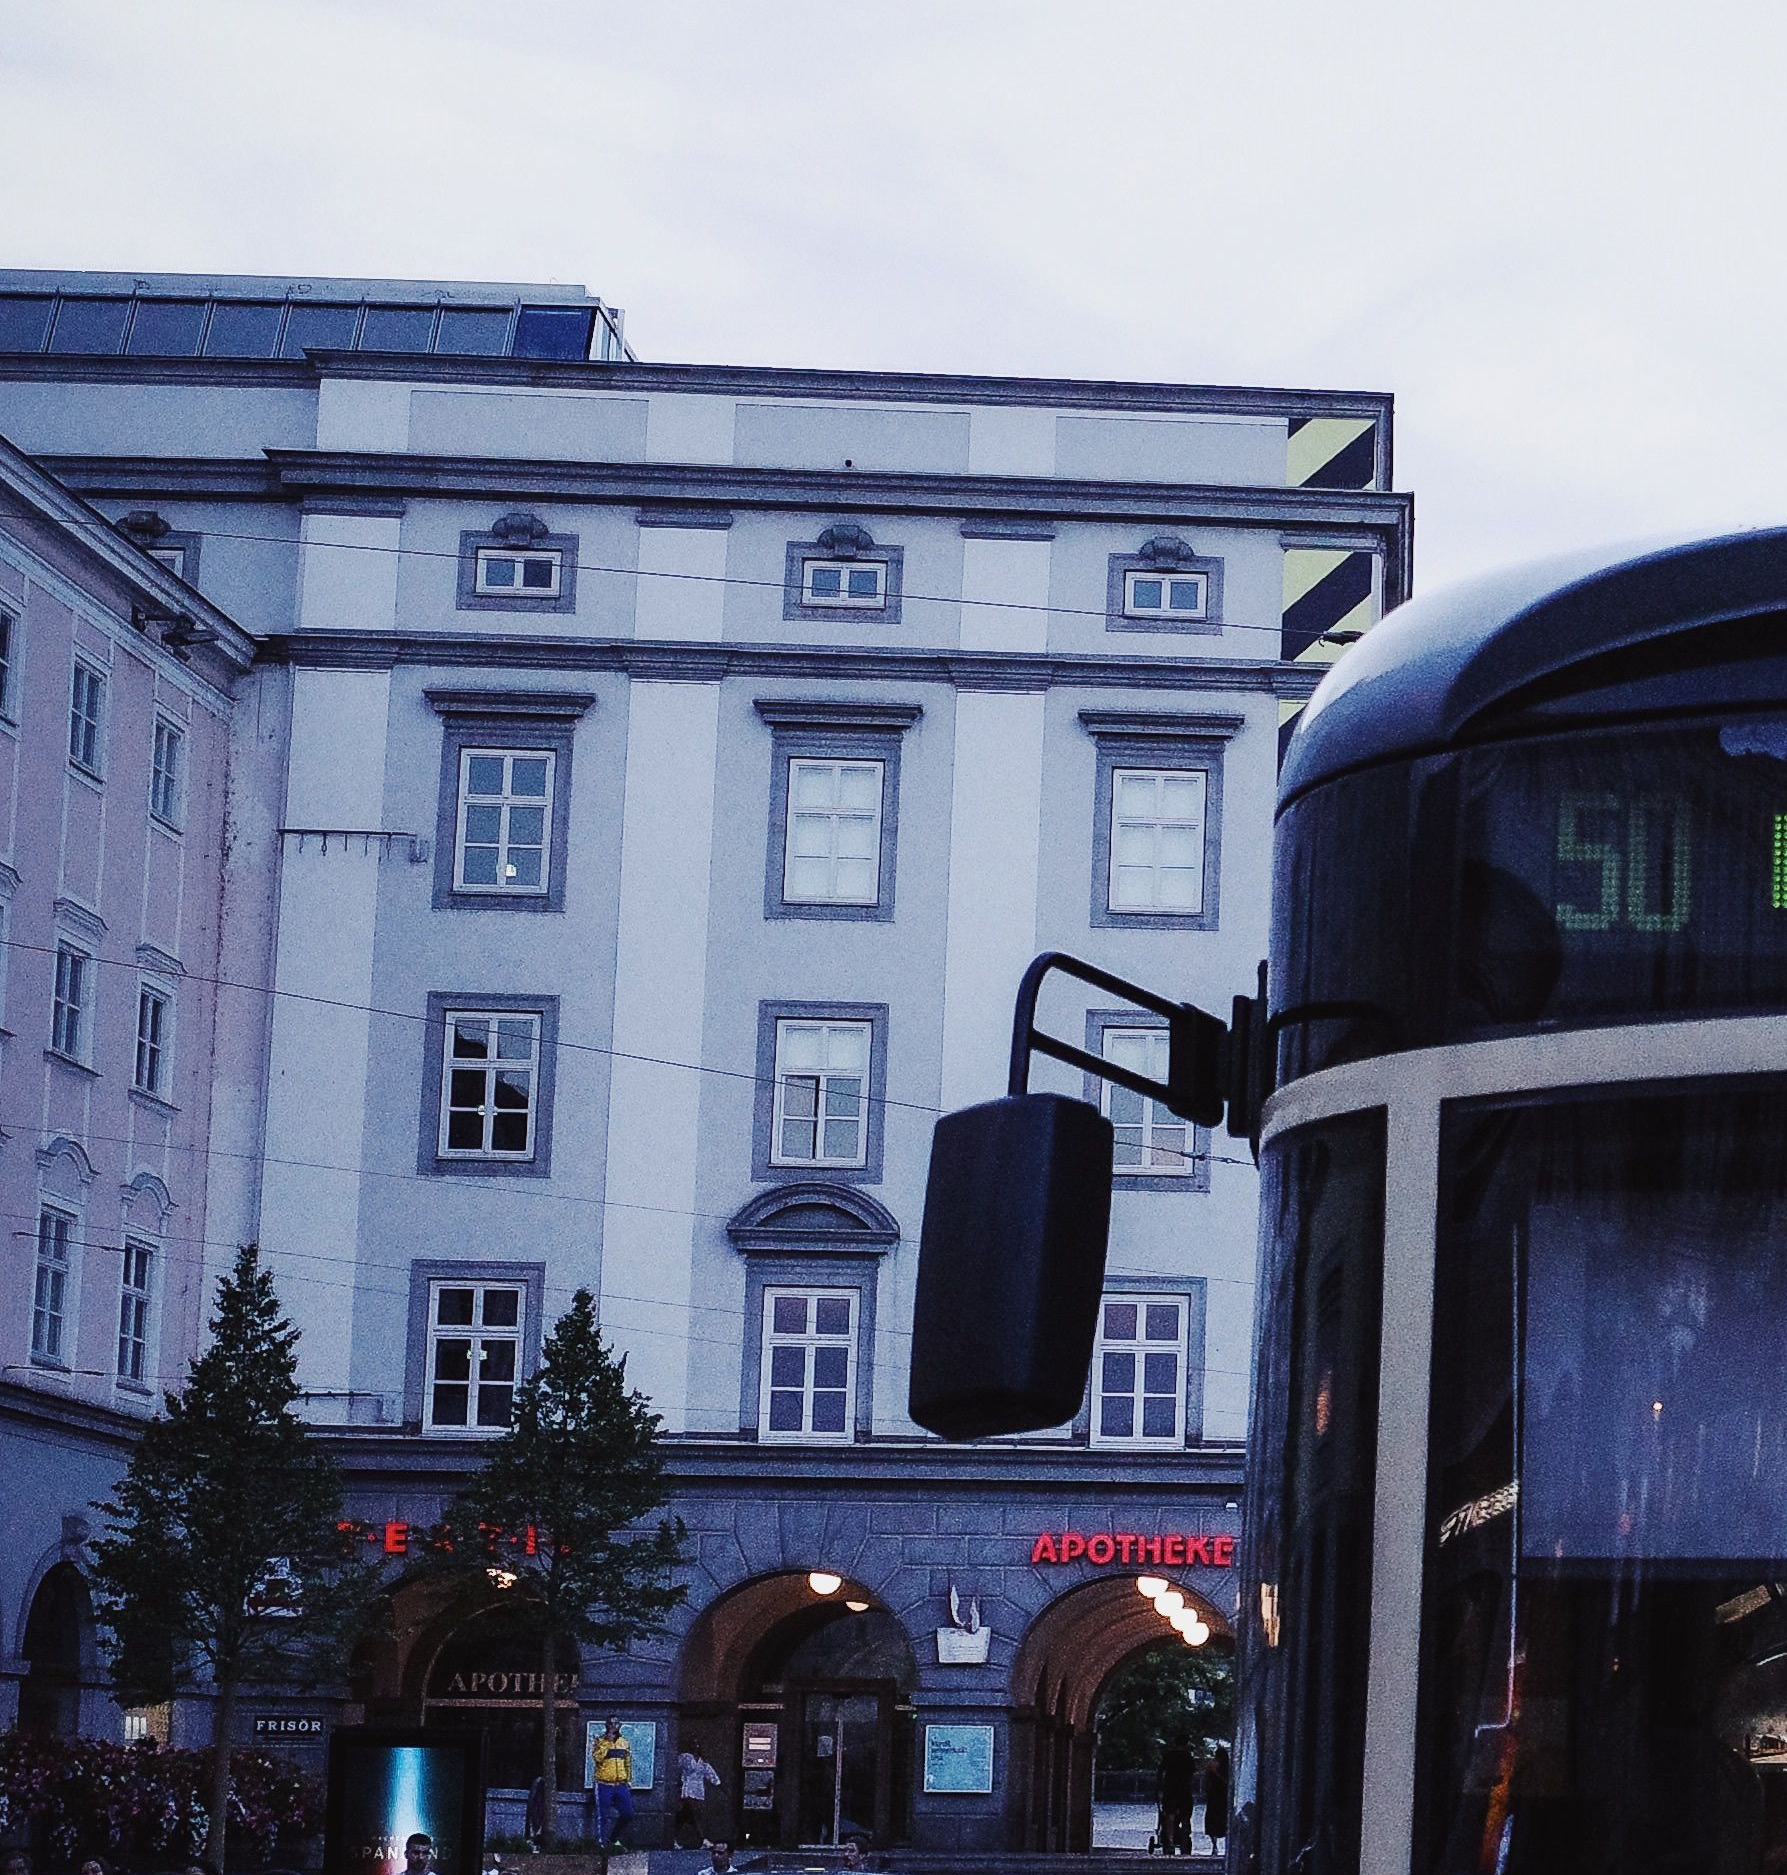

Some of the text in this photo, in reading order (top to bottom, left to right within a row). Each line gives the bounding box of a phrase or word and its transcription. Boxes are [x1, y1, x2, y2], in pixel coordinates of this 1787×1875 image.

[1556, 792, 1692, 932] 50
[1031, 1532, 1233, 1566] APOTHEKE
[256, 1719, 322, 1732] FRISÖR
